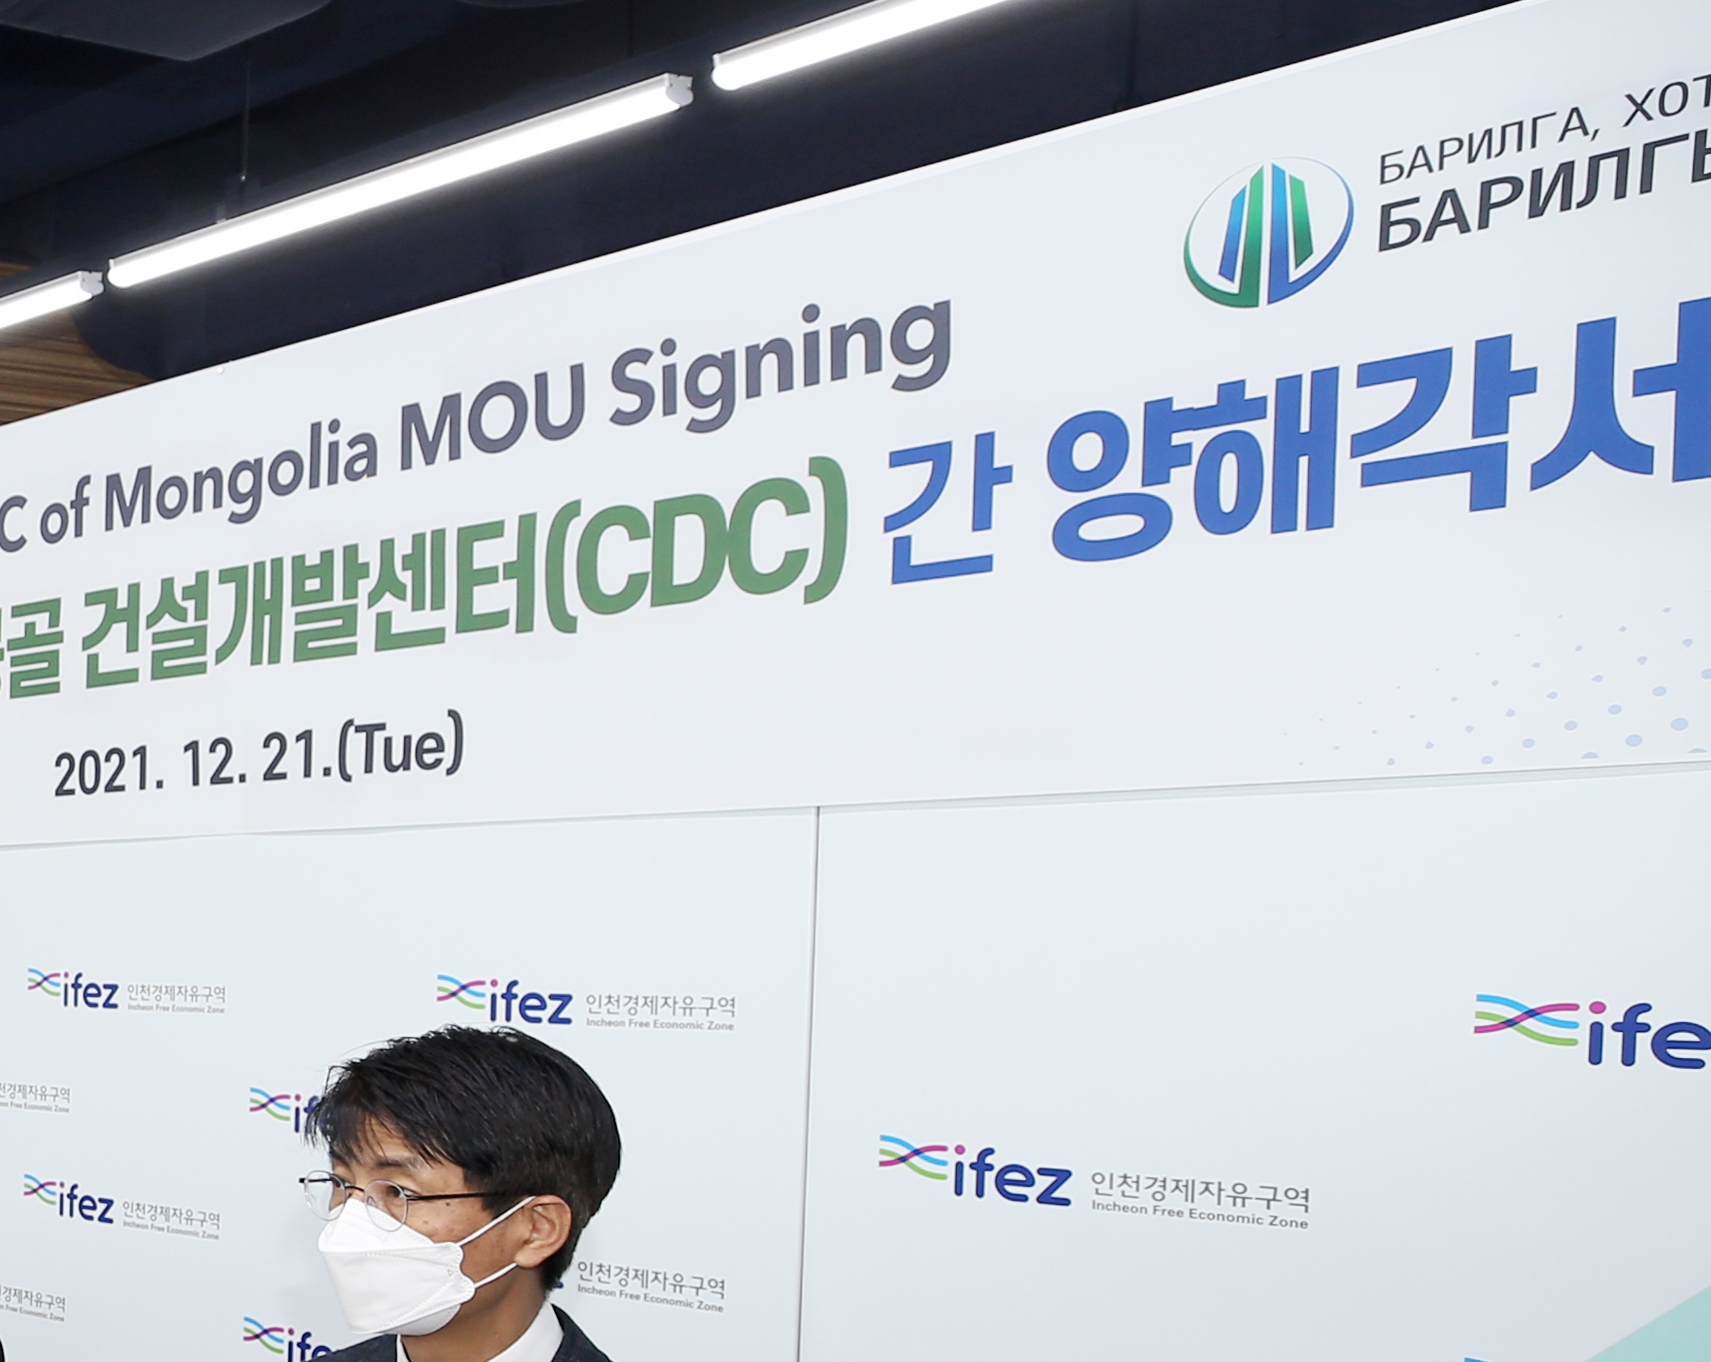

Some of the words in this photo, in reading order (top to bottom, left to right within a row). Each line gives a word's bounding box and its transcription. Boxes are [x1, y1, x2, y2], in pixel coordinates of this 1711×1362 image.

[1379, 106, 1600, 186] БАРИЛГА,
[40, 475, 92, 545] of
[104, 418, 378, 533] Mongolia
[400, 362, 585, 471] MOU
[609, 300, 952, 433] Signing
[80, 456, 848, 688] 건설개발센터(CDC)
[882, 430, 1013, 586] 간
[1046, 298, 1711, 564] 양해각서
[54, 745, 163, 797] 2021.
[181, 733, 247, 788] 12.
[262, 708, 464, 783] 21.(Tue)
[63, 971, 119, 1009] ifez
[127, 984, 225, 1003] 인천경제자유구역
[489, 978, 573, 1025] ifez
[585, 992, 736, 1017] 인천경제자유구역
[586, 1017, 625, 1028] Incheon
[628, 1018, 651, 1029] Free
[653, 1019, 705, 1030] Economic
[707, 1020, 735, 1031] Zone
[954, 1144, 1073, 1207] ifez
[1091, 1171, 1310, 1214] 인천경제자유구역
[59, 1181, 115, 1224] ifez
[122, 1200, 221, 1230] 인천경제자유구역
[1091, 1199, 1149, 1216] Incheon
[1153, 1204, 1185, 1219] Free
[1189, 1208, 1264, 1226] Economic
[1268, 1214, 1309, 1230] Zone
[577, 1261, 725, 1300] 인천경제자유구역
[577, 1283, 617, 1298] Incheon
[619, 1289, 641, 1301] Free
[643, 1293, 695, 1309] Economic
[696, 1300, 724, 1313] Zone
